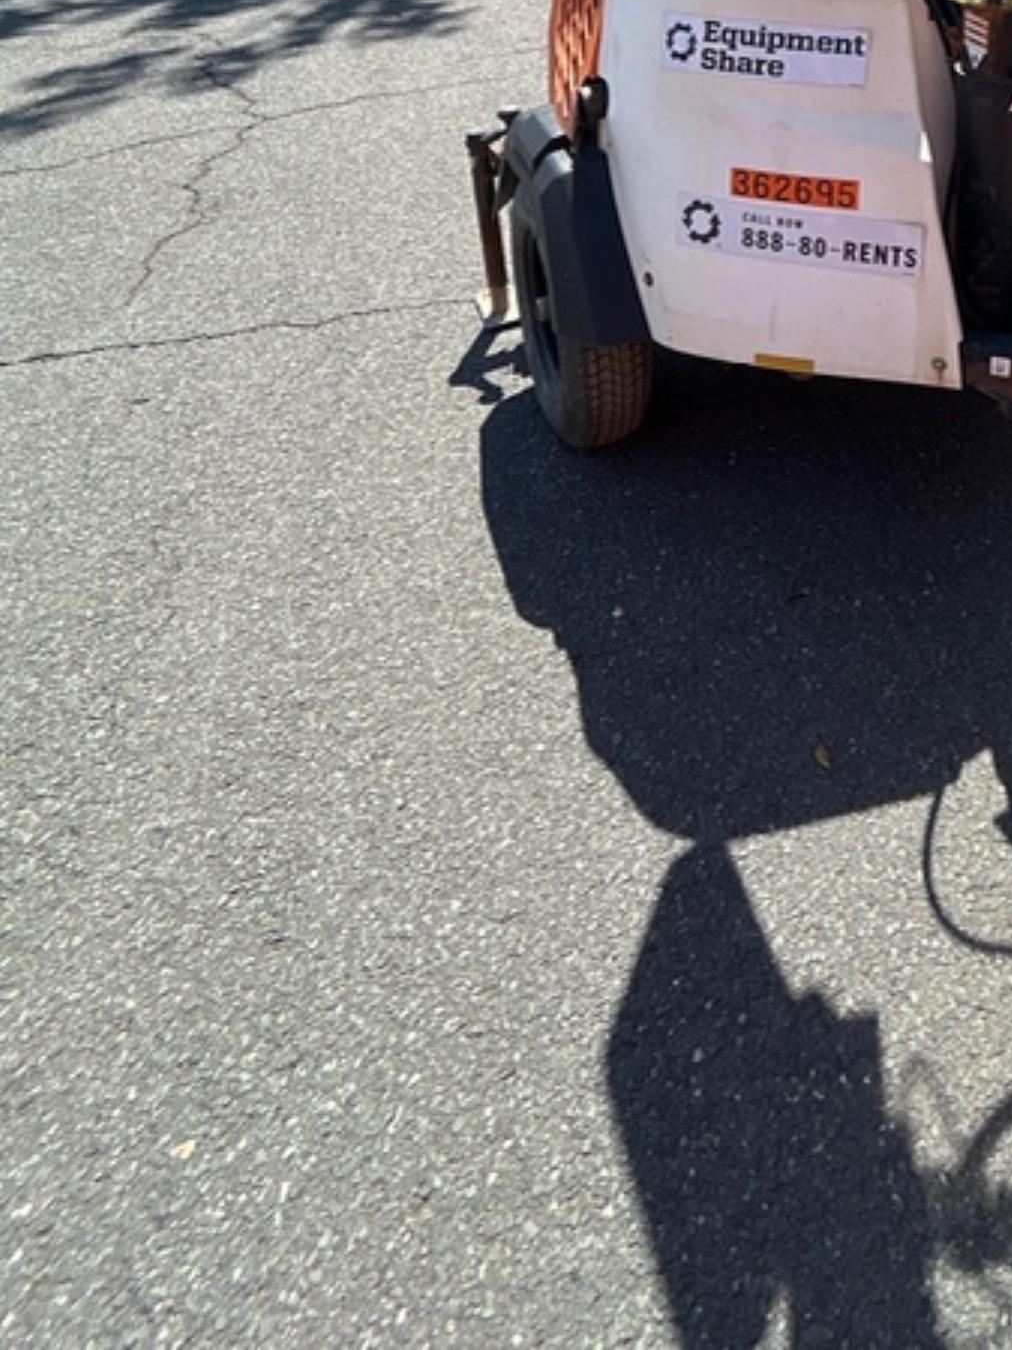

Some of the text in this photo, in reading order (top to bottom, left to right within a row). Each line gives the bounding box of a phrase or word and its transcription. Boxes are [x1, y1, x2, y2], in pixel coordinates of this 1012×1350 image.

[702, 20, 866, 57] Equipment
[701, 48, 785, 78] Share
[732, 170, 857, 208] 362695
[741, 212, 772, 226] CALL
[740, 227, 918, 268] 888-80-RENTS
